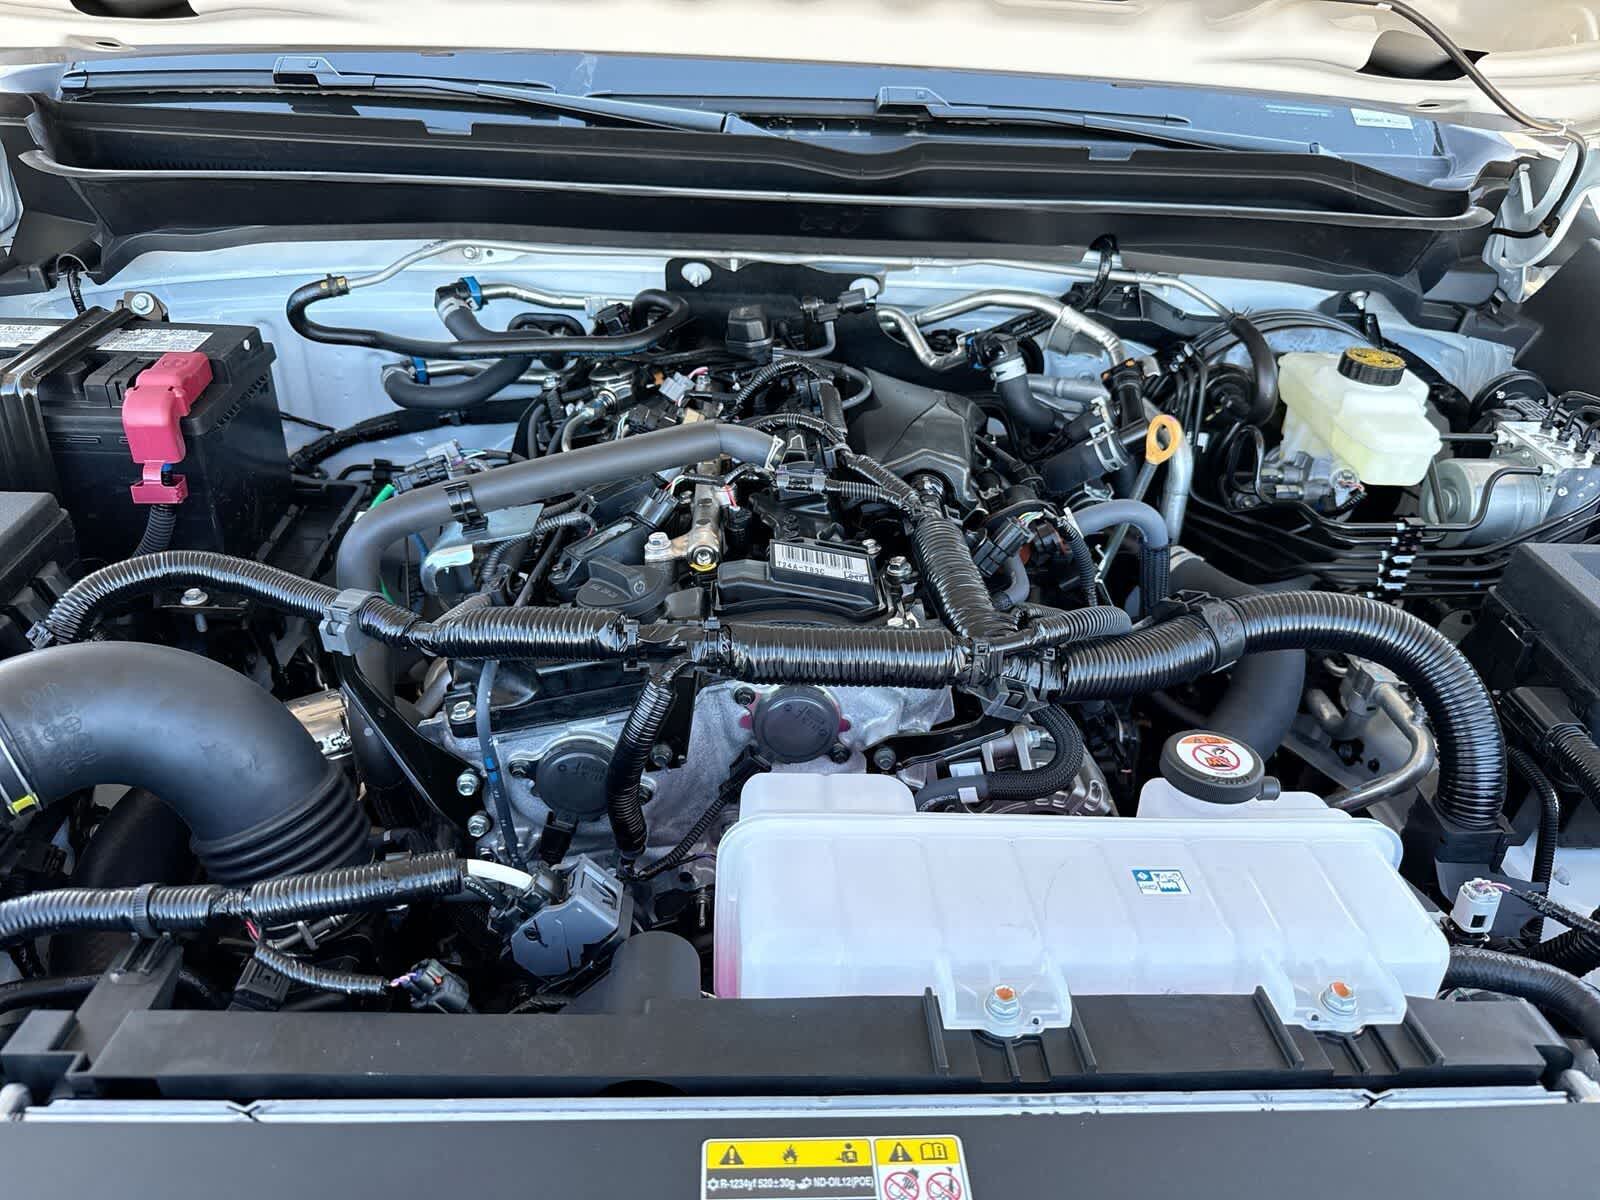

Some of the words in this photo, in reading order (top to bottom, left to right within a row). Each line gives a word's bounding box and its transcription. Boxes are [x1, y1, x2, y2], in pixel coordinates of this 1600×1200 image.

[720, 1178, 757, 1191] R-1234yf
[758, 1178, 796, 1190] 520±30g
[813, 1176, 874, 1189] ND-OIL12(POE)
